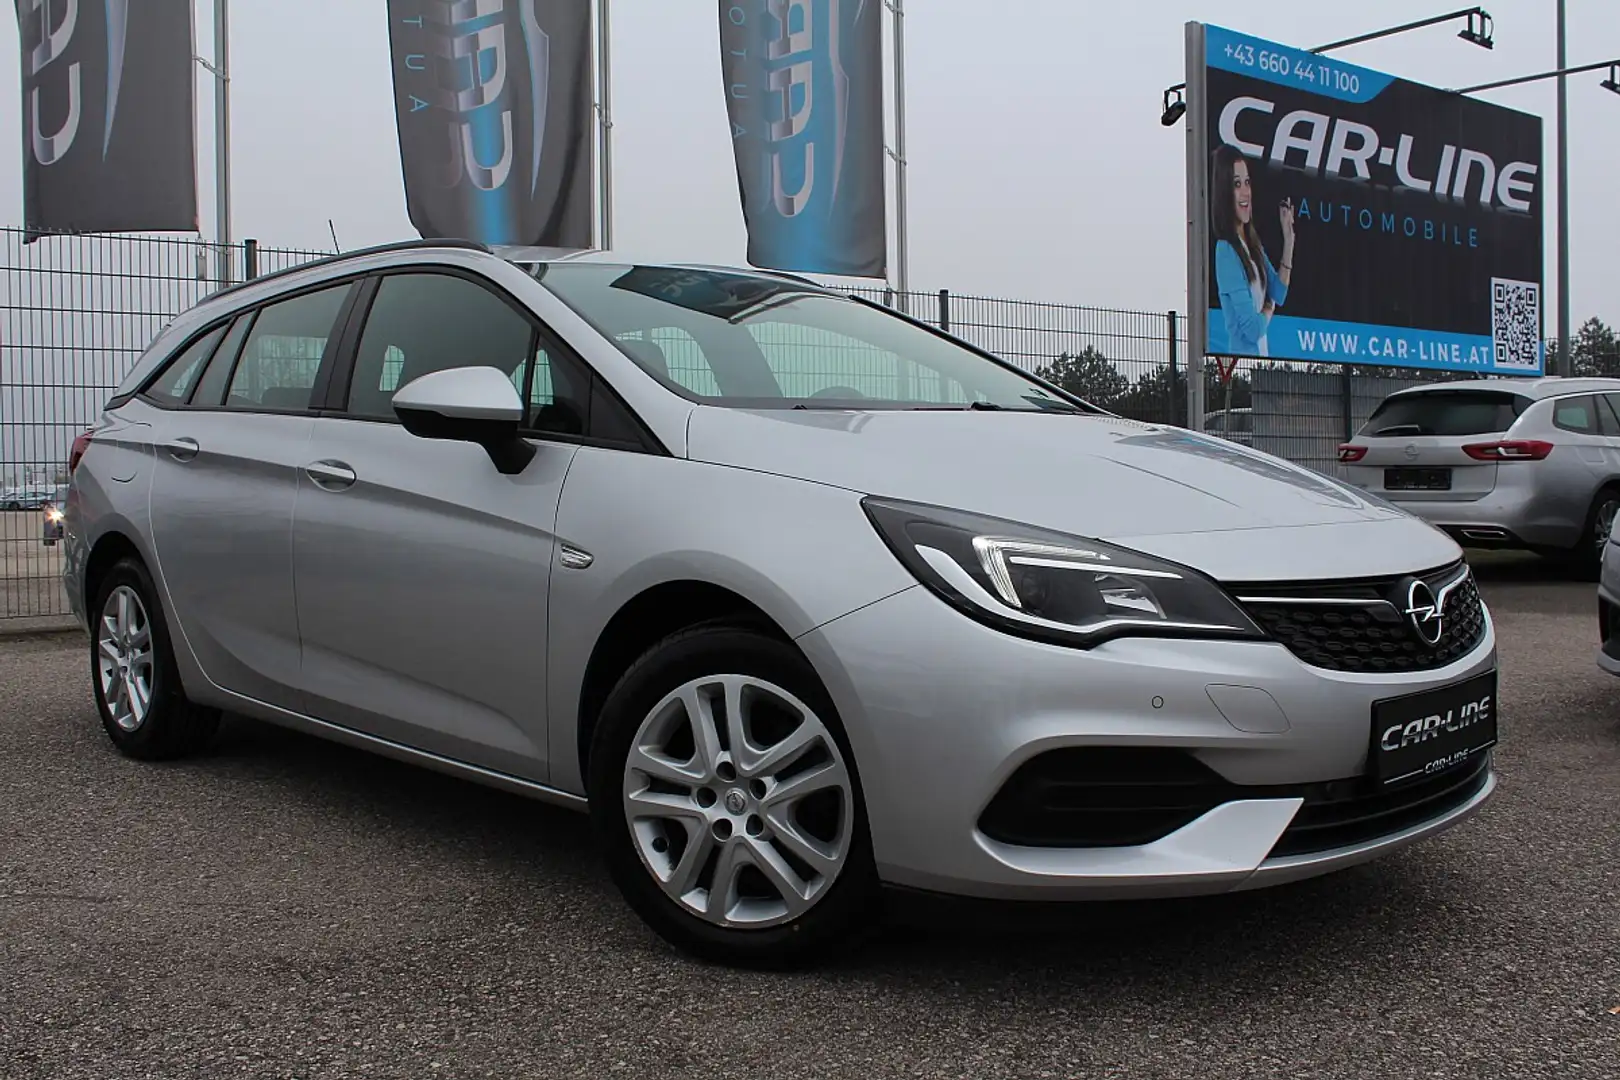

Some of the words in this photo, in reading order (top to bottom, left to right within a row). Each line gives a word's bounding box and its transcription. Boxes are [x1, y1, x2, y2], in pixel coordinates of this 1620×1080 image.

[1224, 43, 1255, 67] +43
[1259, 50, 1290, 76] 660
[1294, 60, 1315, 83] 44
[1319, 66, 1330, 87] 11
[1334, 70, 1360, 94] 100
[1298, 198, 1479, 247] AUTOMOBILE
[1298, 330, 1489, 365] WWW.CAR-LINE.AT
